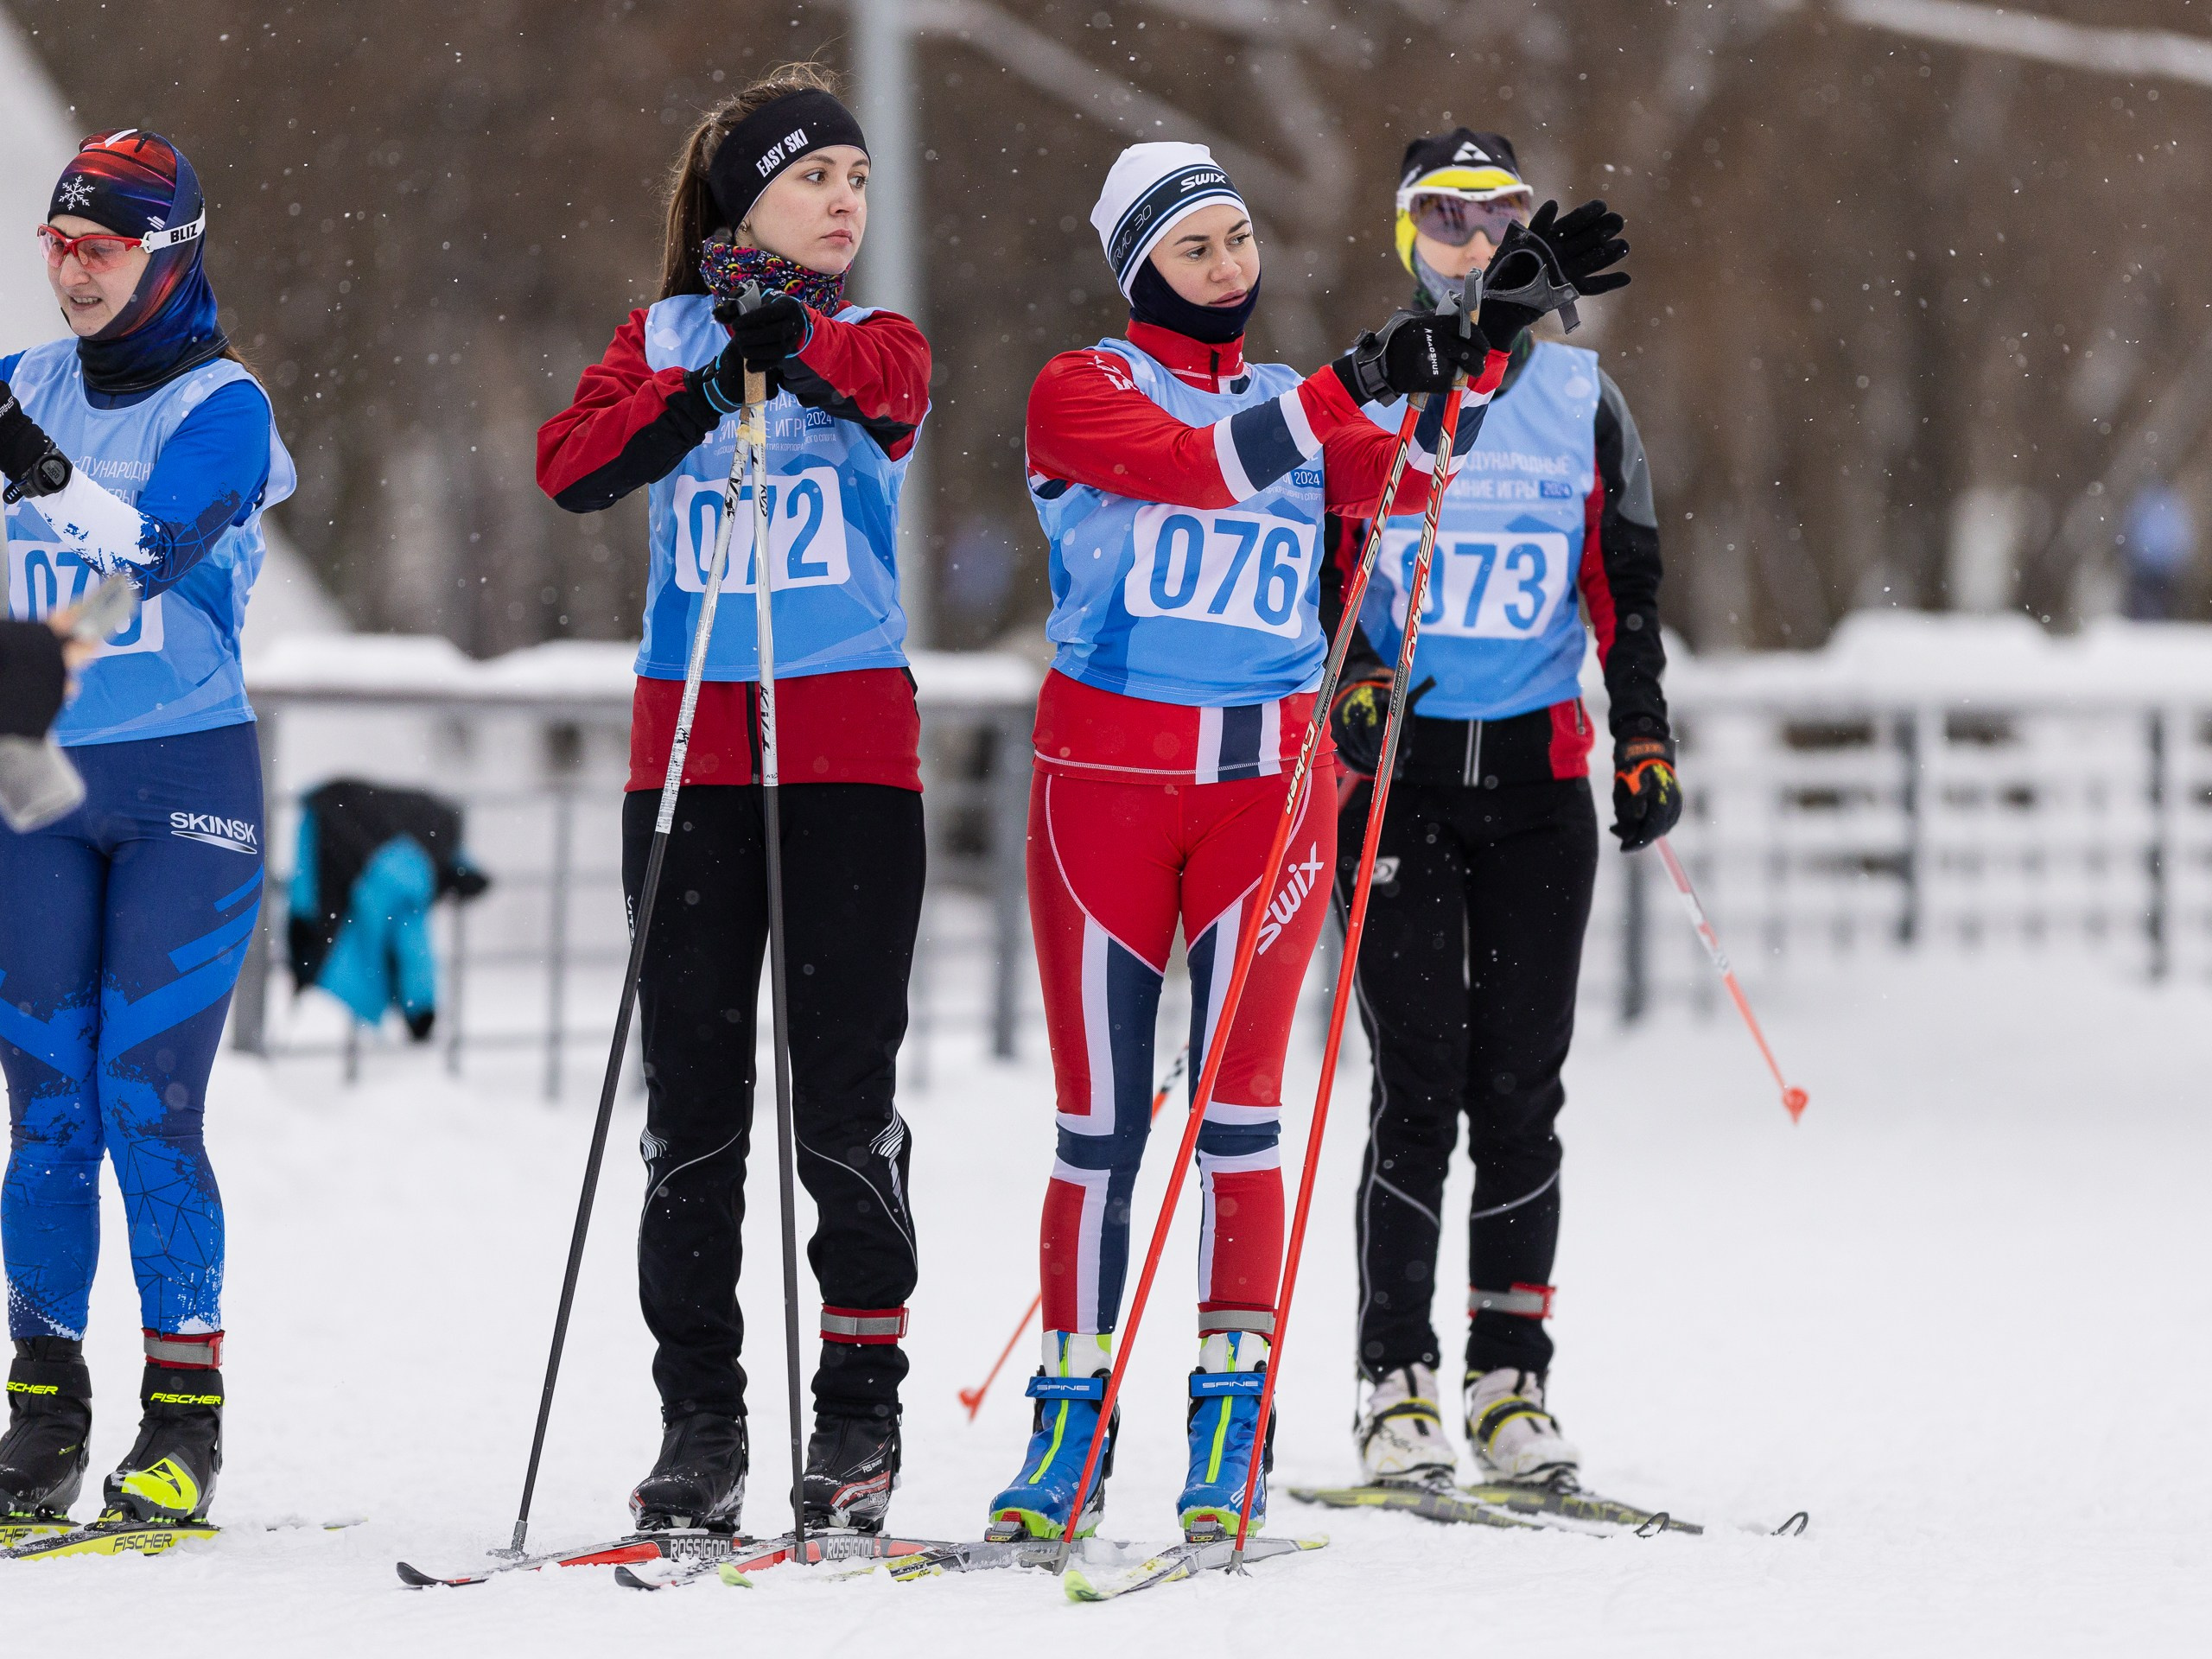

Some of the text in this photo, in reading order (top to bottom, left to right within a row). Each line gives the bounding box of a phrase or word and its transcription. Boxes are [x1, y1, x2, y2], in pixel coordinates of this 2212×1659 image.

[755, 128, 809, 178] EASY SKI
[1134, 204, 1153, 232] 30
[169, 223, 199, 244] BLIZ
[806, 410, 832, 427] 2024
[1294, 471, 1320, 485] 2024
[689, 478, 830, 586] 072
[1149, 513, 1301, 626] 076
[1401, 541, 1547, 632] 073
[169, 812, 257, 845] SKINSK
[150, 1392, 222, 1406] FISCHER
[113, 1533, 173, 1553] FISCHER
